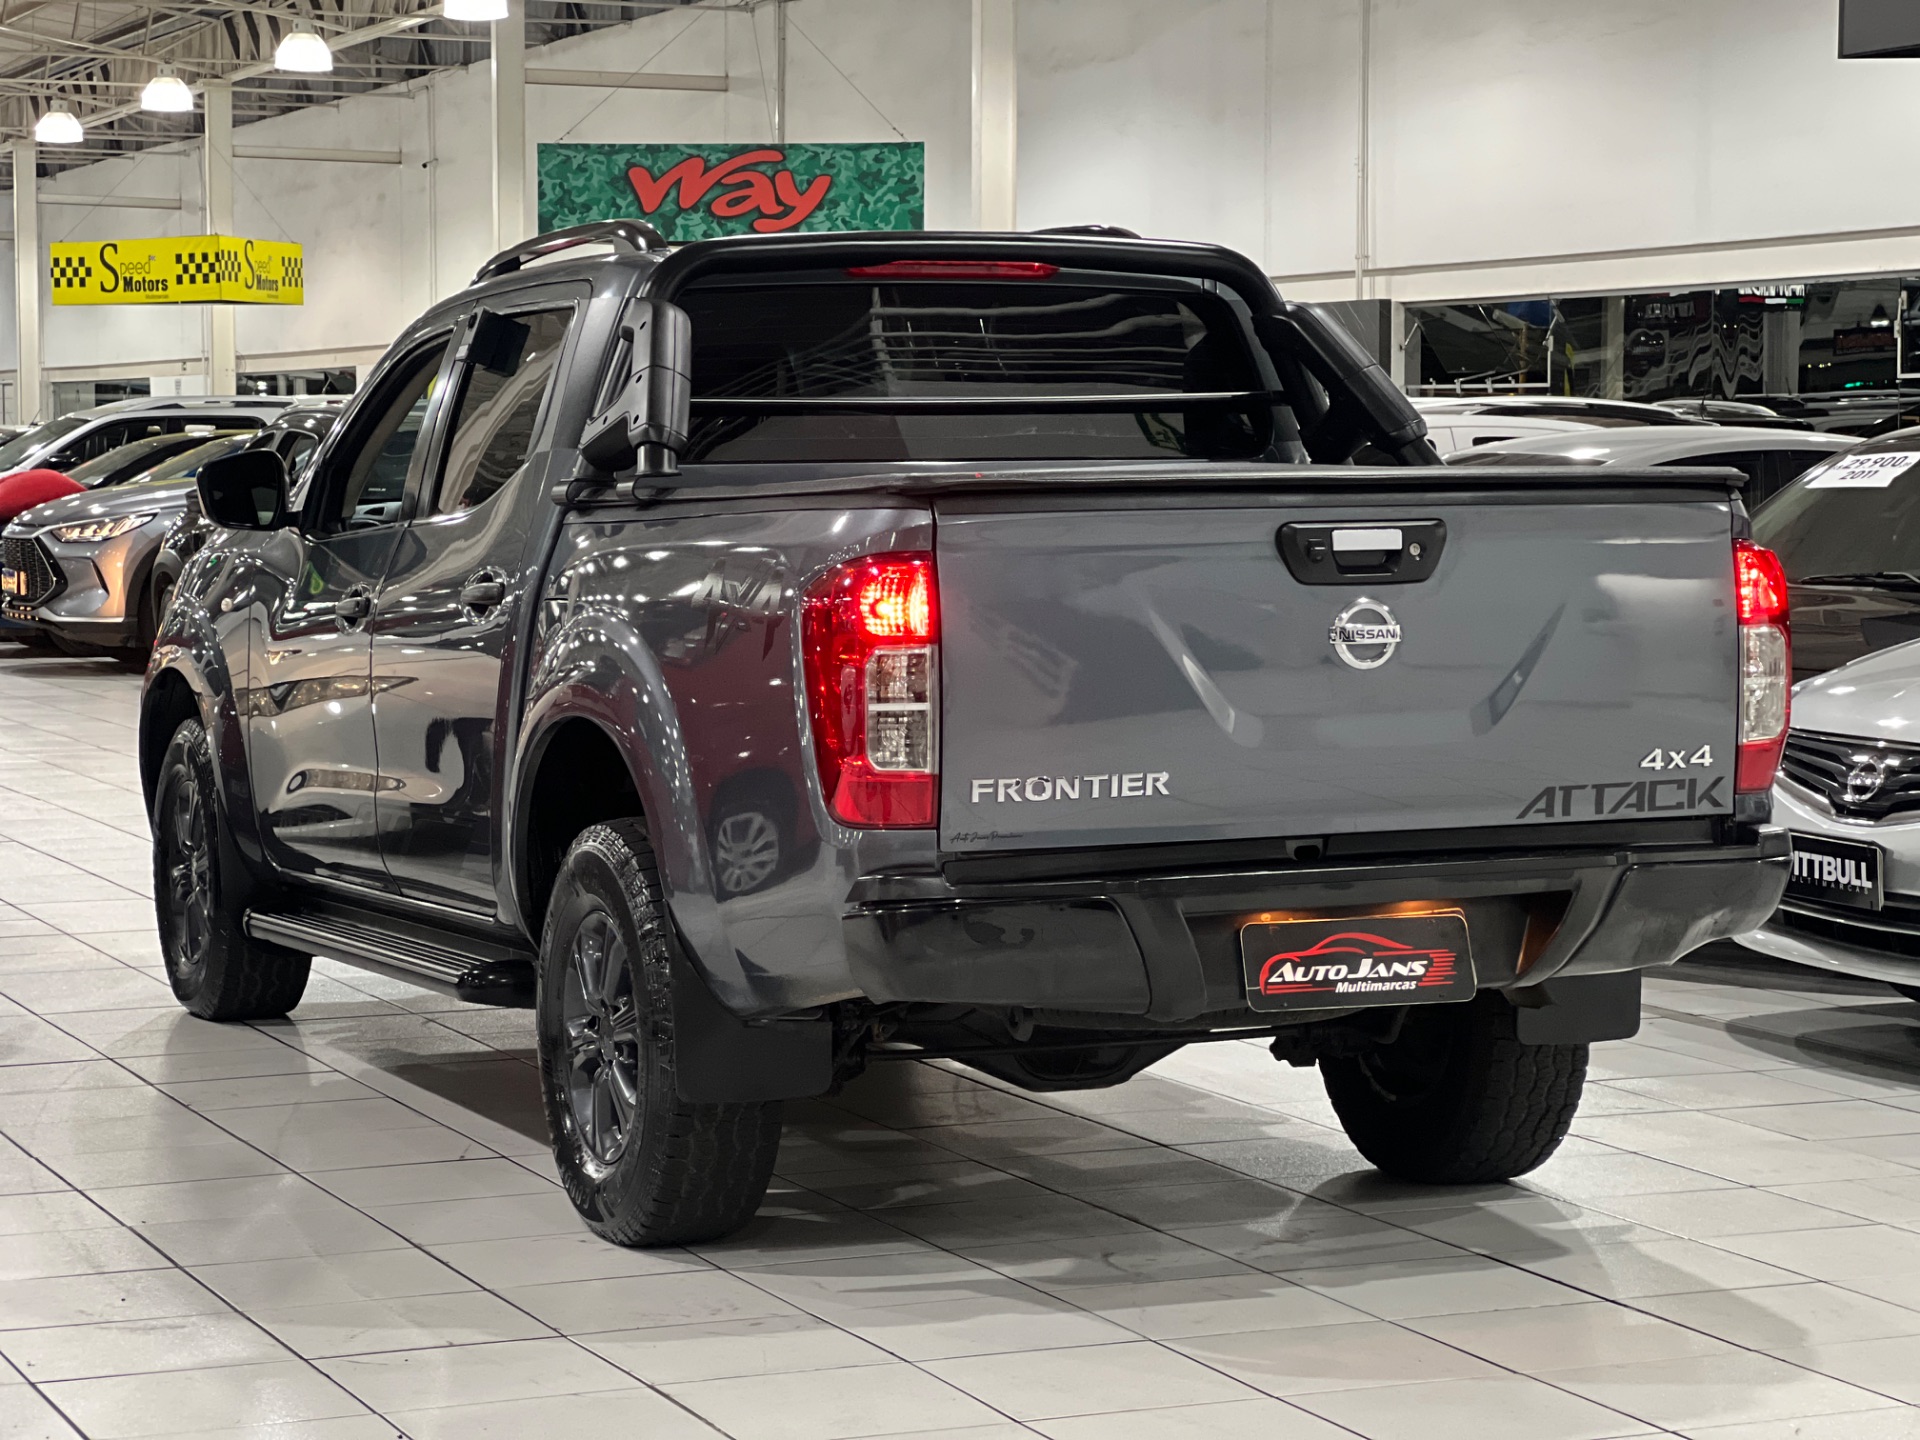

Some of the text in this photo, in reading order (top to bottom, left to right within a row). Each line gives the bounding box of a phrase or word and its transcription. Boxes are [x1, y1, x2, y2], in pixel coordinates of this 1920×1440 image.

[100, 243, 151, 293] Speed
[123, 276, 169, 293] Motors
[256, 274, 279, 292] Motors
[1838, 469, 1880, 481] 2011
[1339, 628, 1396, 641] NISSAN
[1639, 744, 1714, 771] 4x4
[971, 771, 1170, 803] FRONTIER
[1515, 775, 1726, 820] ATTACK
[1793, 850, 1873, 889] ITTBULL
[1791, 875, 1869, 895] ULTIMARCAS
[1335, 980, 1417, 994] Multimarcas
